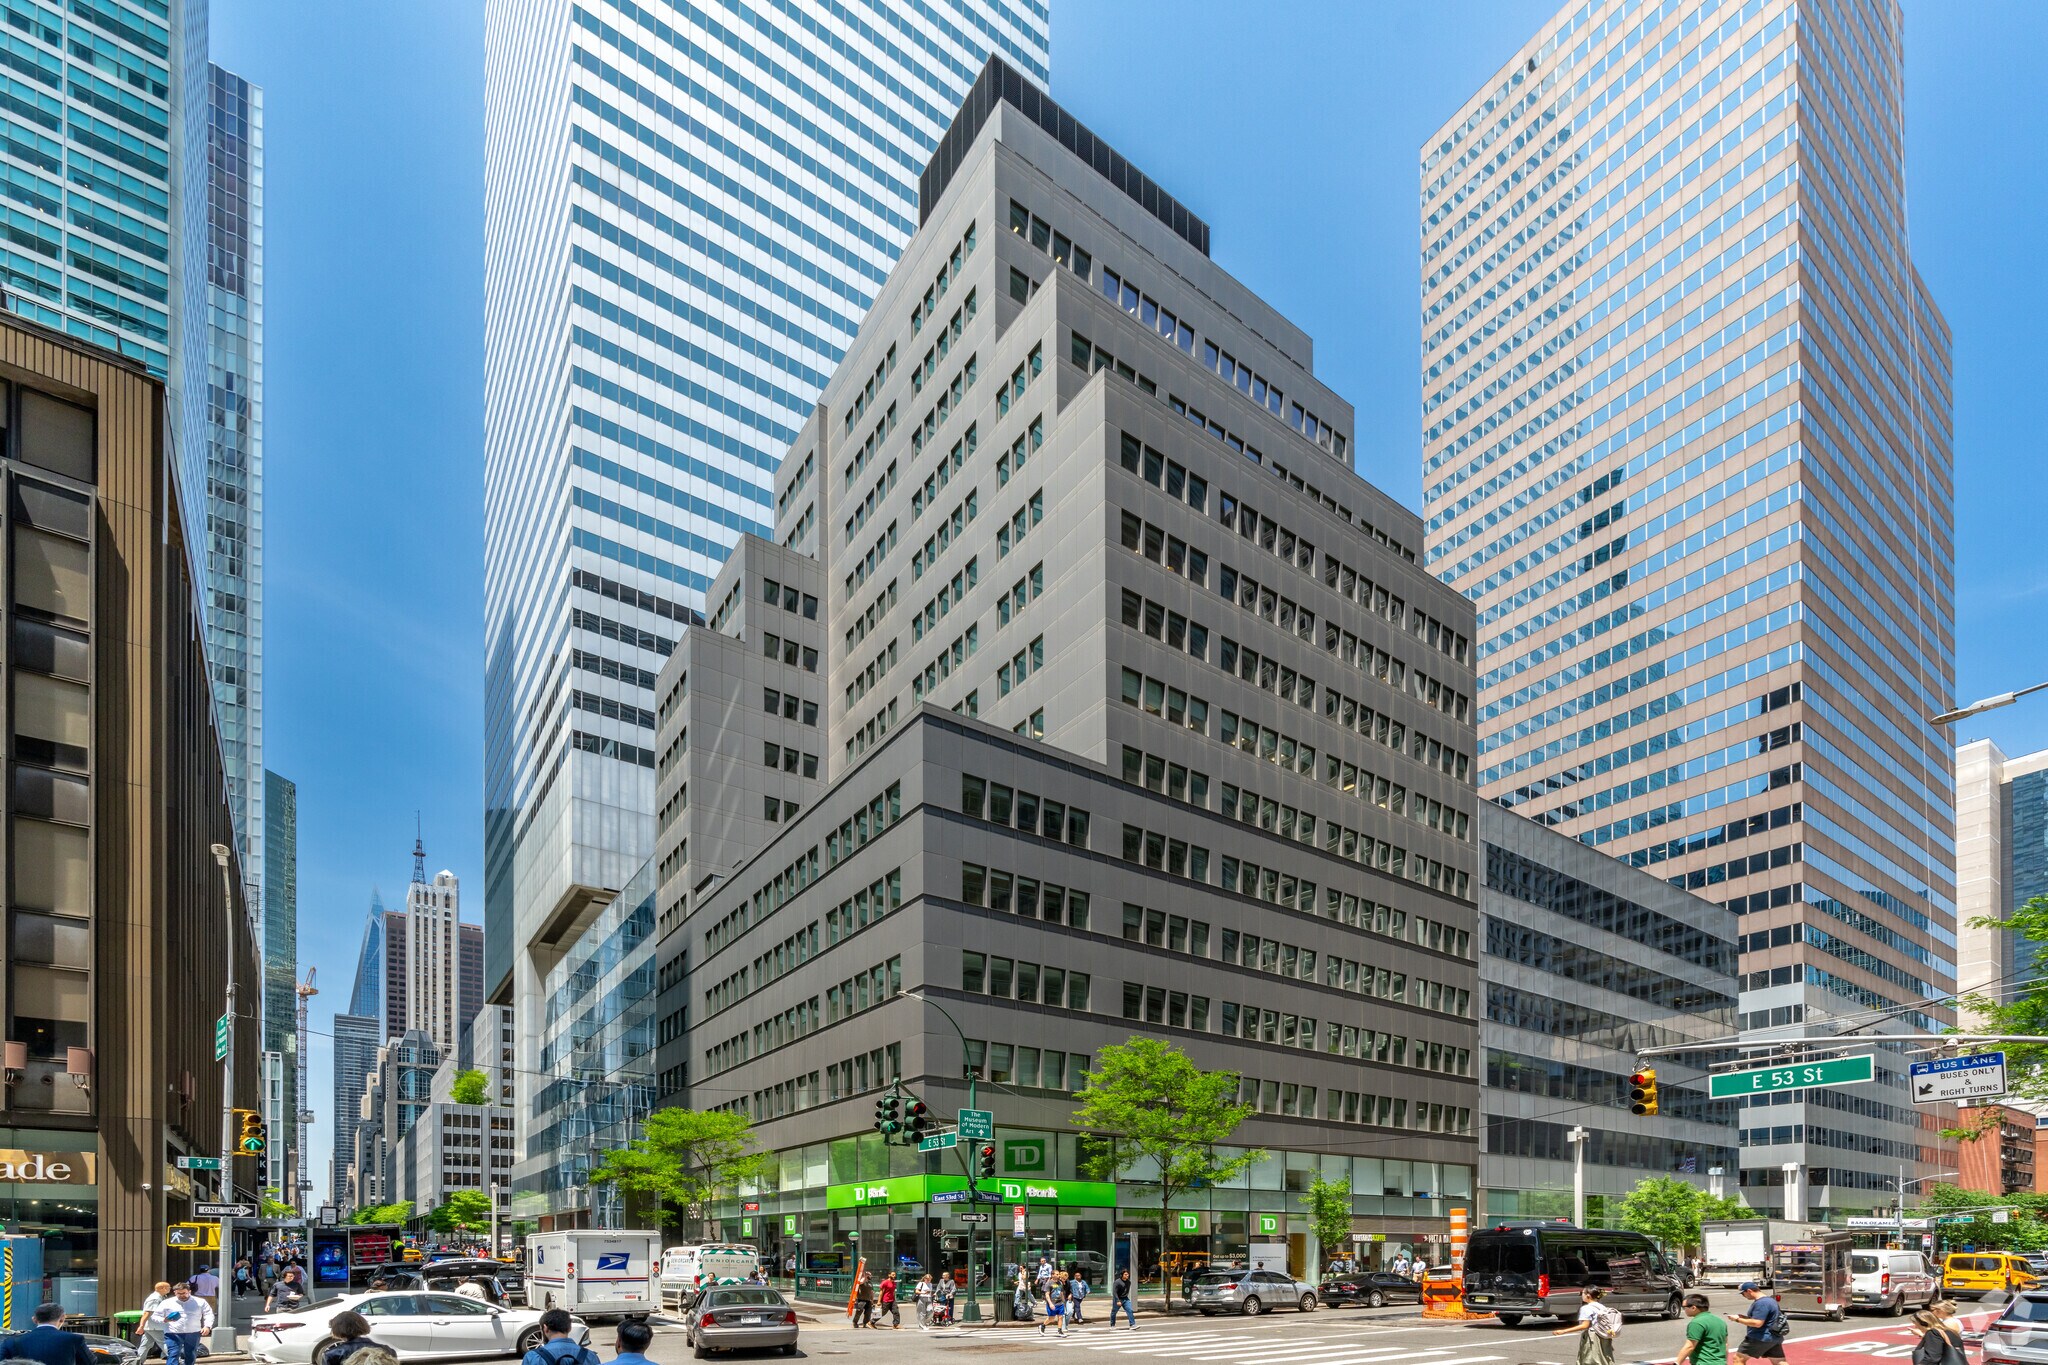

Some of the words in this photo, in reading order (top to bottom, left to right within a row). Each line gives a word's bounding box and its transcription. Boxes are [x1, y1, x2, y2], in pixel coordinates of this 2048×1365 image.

[1934, 1060, 1958, 1070] BUS
[1962, 1056, 1996, 1066] LANE
[1752, 1074, 1763, 1089] E
[1771, 1070, 1794, 1086] 53
[1803, 1067, 1824, 1082] St
[1940, 1070, 1969, 1080] BUSES
[1972, 1066, 1996, 1076] ONLY
[1940, 1088, 1966, 1096] RIGHT
[1969, 1084, 1998, 1094] TURNS
[928, 1140, 932, 1148] E
[932, 1138, 940, 1147] 53
[940, 1137, 946, 1146] St
[1008, 1146, 1040, 1165] TD
[0, 1154, 71, 1180] ade
[196, 1159, 202, 1168] 3
[854, 1188, 865, 1200] TD
[868, 1186, 889, 1198] Bank
[1002, 1184, 1021, 1198] TD
[1026, 1186, 1058, 1198] Bank
[1180, 1216, 1197, 1229] TD
[1261, 1218, 1276, 1230] TD
